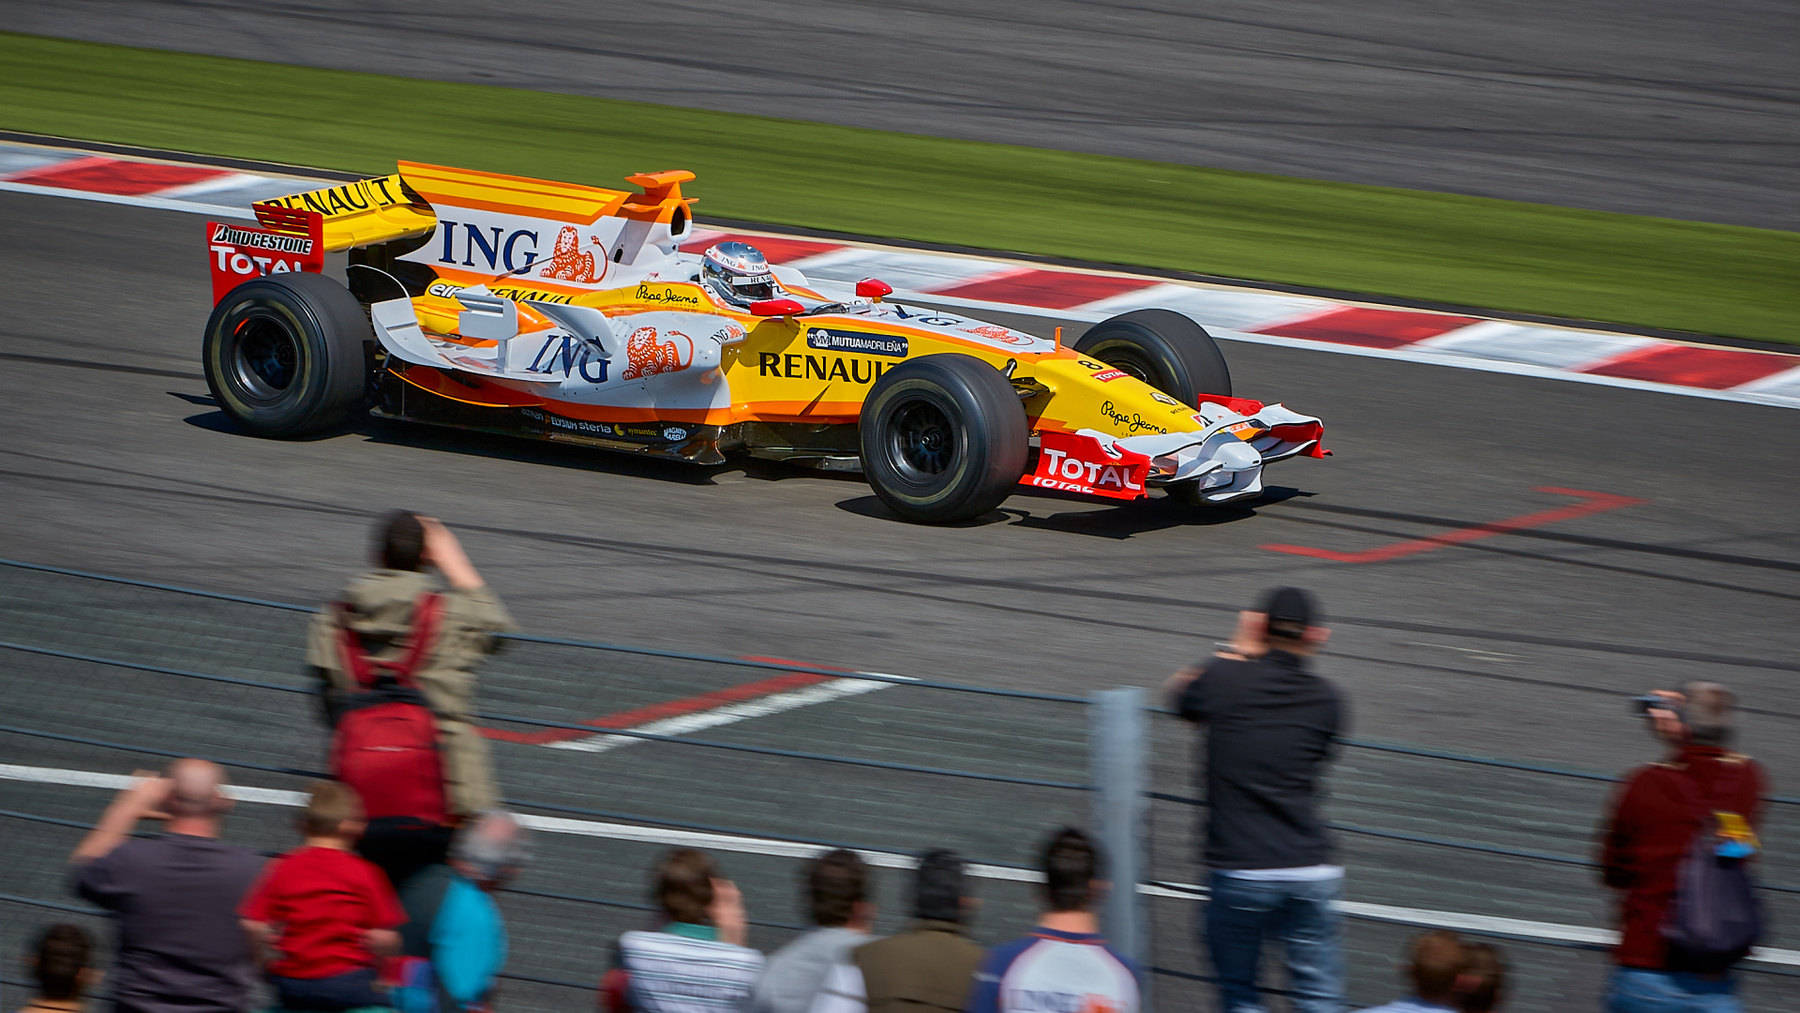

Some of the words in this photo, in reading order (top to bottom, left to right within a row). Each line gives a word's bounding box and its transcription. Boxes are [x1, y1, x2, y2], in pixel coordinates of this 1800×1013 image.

[211, 223, 313, 255] BRIDGESTONE
[438, 220, 538, 275] ING
[721, 256, 736, 267] ING
[635, 284, 662, 302] Pepe
[659, 288, 699, 304] Jeans
[525, 335, 611, 383] ING
[758, 352, 900, 384] RENAUL
[1101, 400, 1131, 426] Pepe
[1129, 413, 1168, 435] Jeans
[1044, 448, 1141, 490] TOTAL
